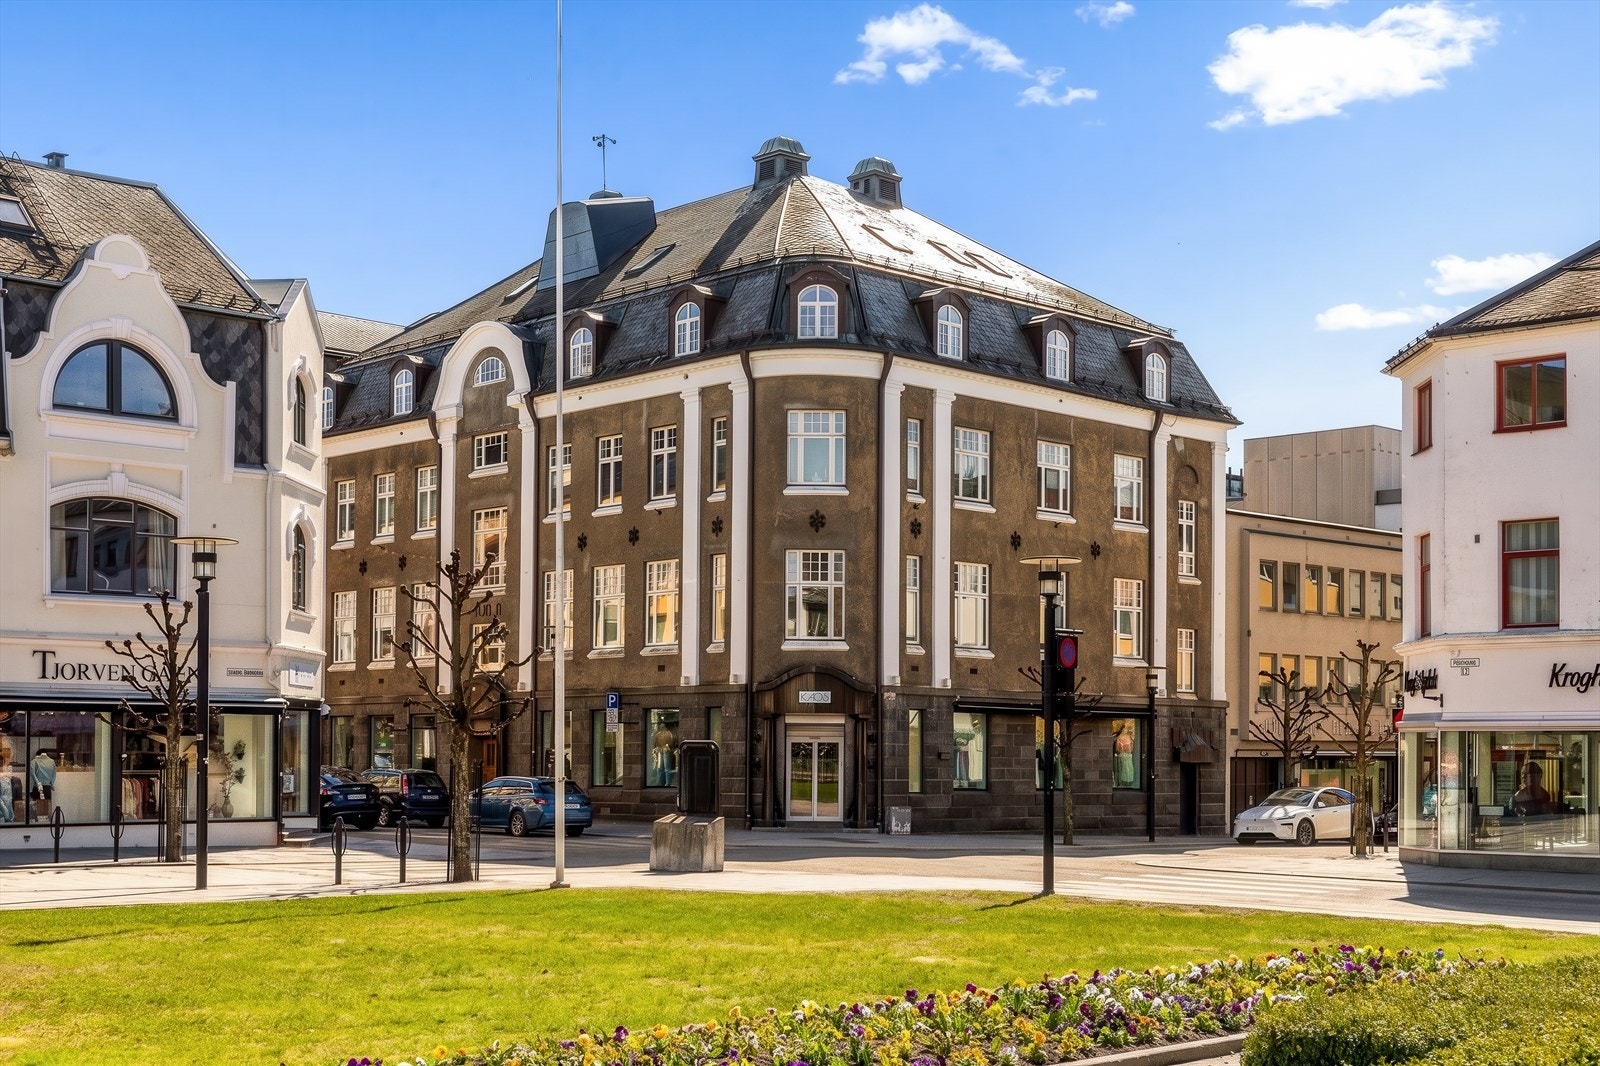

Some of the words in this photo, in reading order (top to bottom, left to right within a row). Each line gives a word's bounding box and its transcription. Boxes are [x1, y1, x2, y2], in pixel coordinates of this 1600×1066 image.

[32, 650, 136, 681] TJORVEN
[609, 695, 616, 706] P
[800, 692, 830, 702] KAOS
